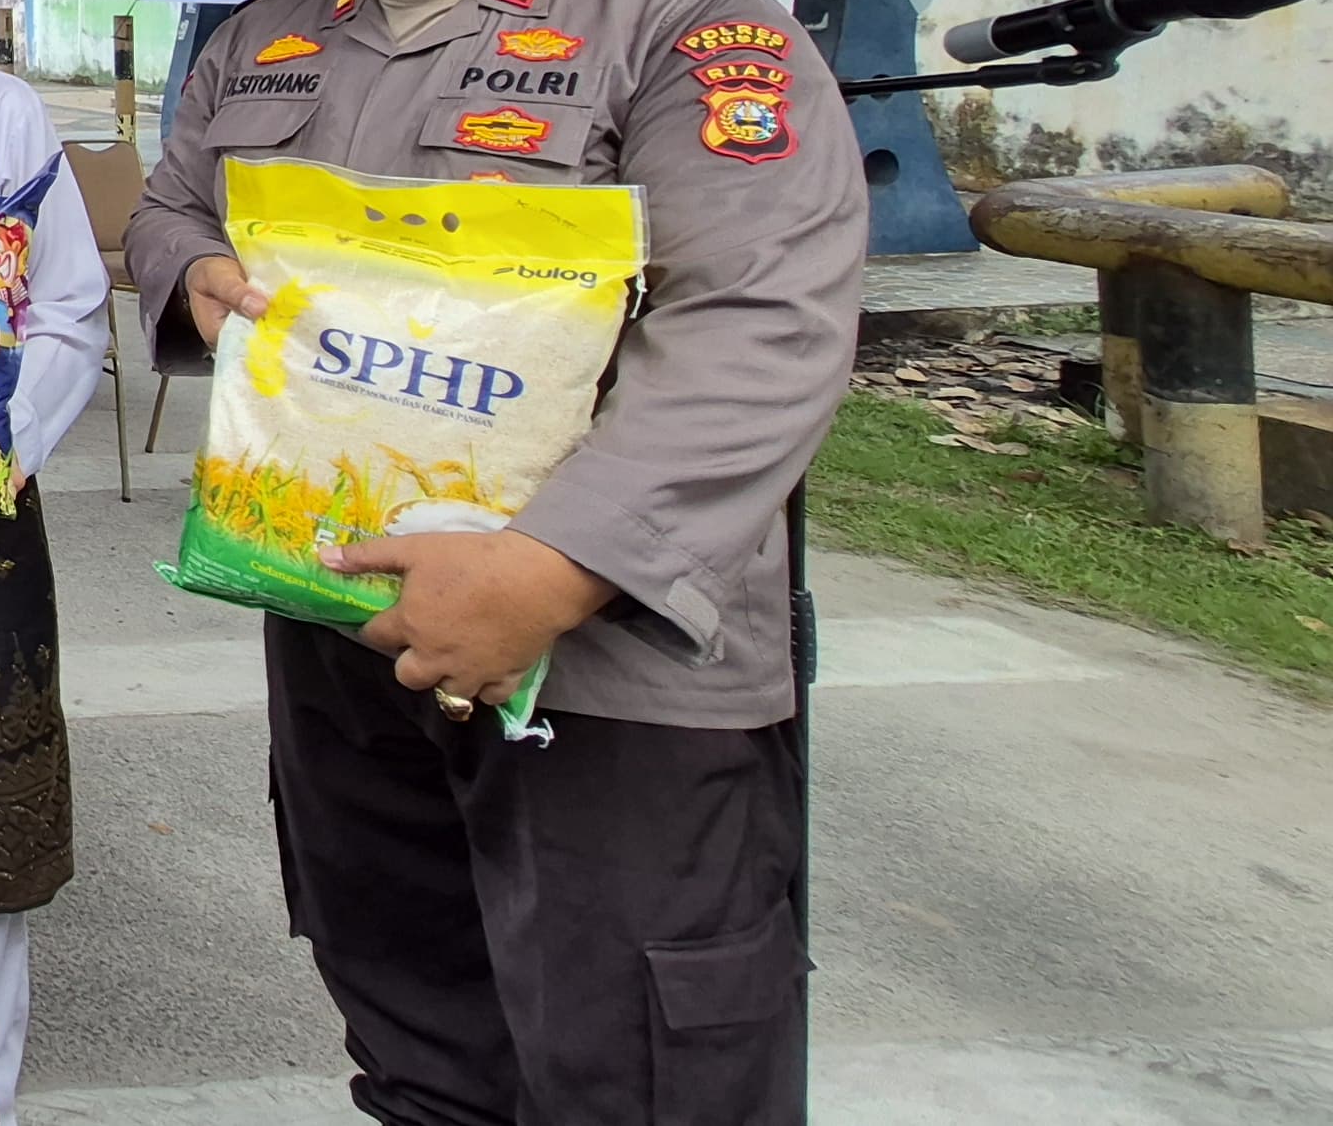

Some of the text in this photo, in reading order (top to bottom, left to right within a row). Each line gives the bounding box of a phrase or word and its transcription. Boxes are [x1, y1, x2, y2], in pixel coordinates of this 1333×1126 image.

[685, 25, 785, 48] POLRES
[460, 67, 580, 97] POLRI
[707, 64, 783, 83] RIAU
[518, 265, 597, 288] bulog
[313, 328, 525, 416] SPHP
[309, 581, 343, 602] Beras
